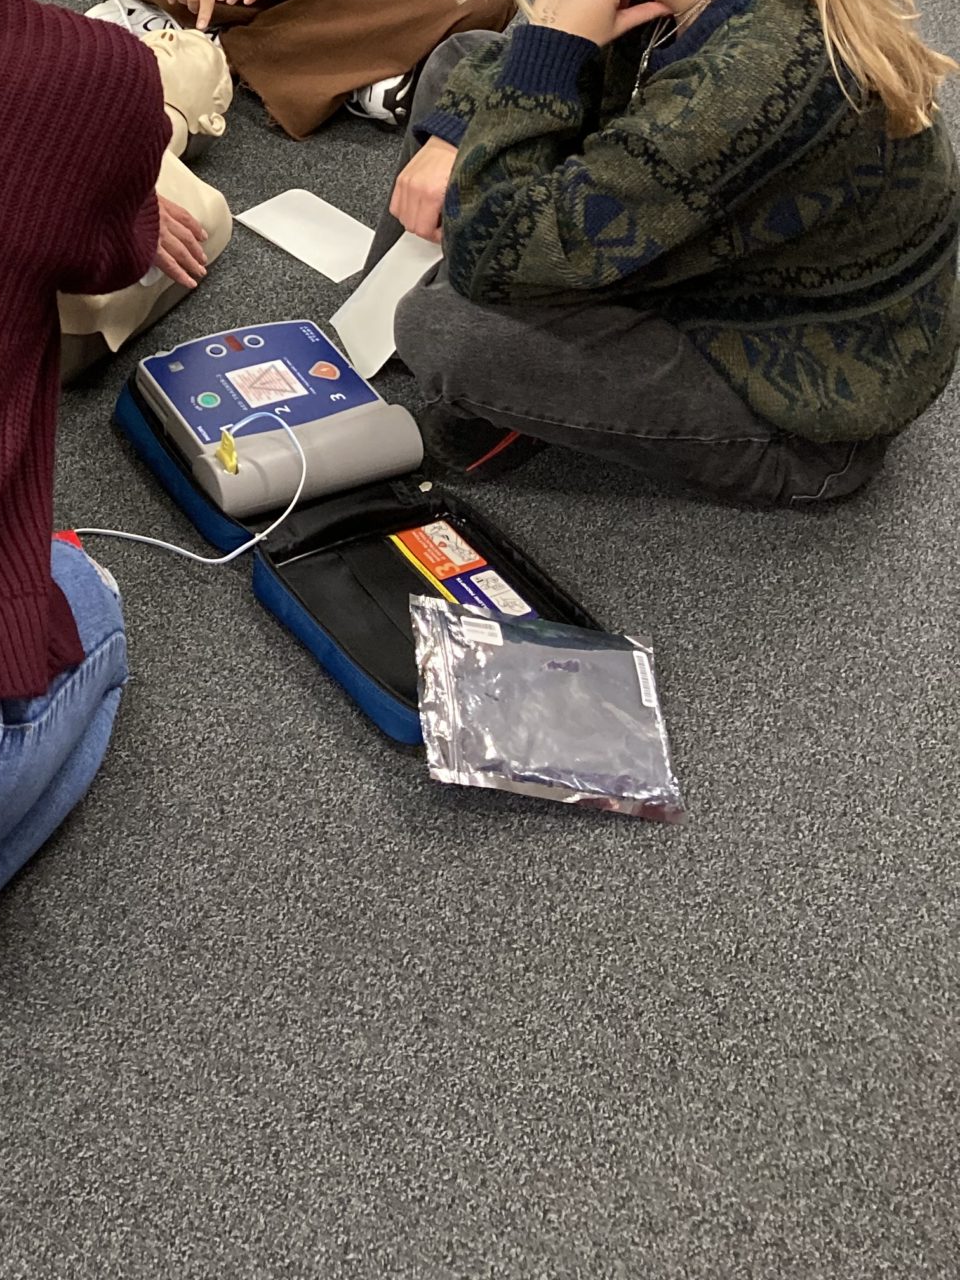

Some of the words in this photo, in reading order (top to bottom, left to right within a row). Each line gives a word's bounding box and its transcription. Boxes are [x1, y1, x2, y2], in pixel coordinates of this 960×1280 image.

[330, 392, 347, 402] 3
[274, 405, 291, 416] 2
[434, 562, 460, 577] 3
